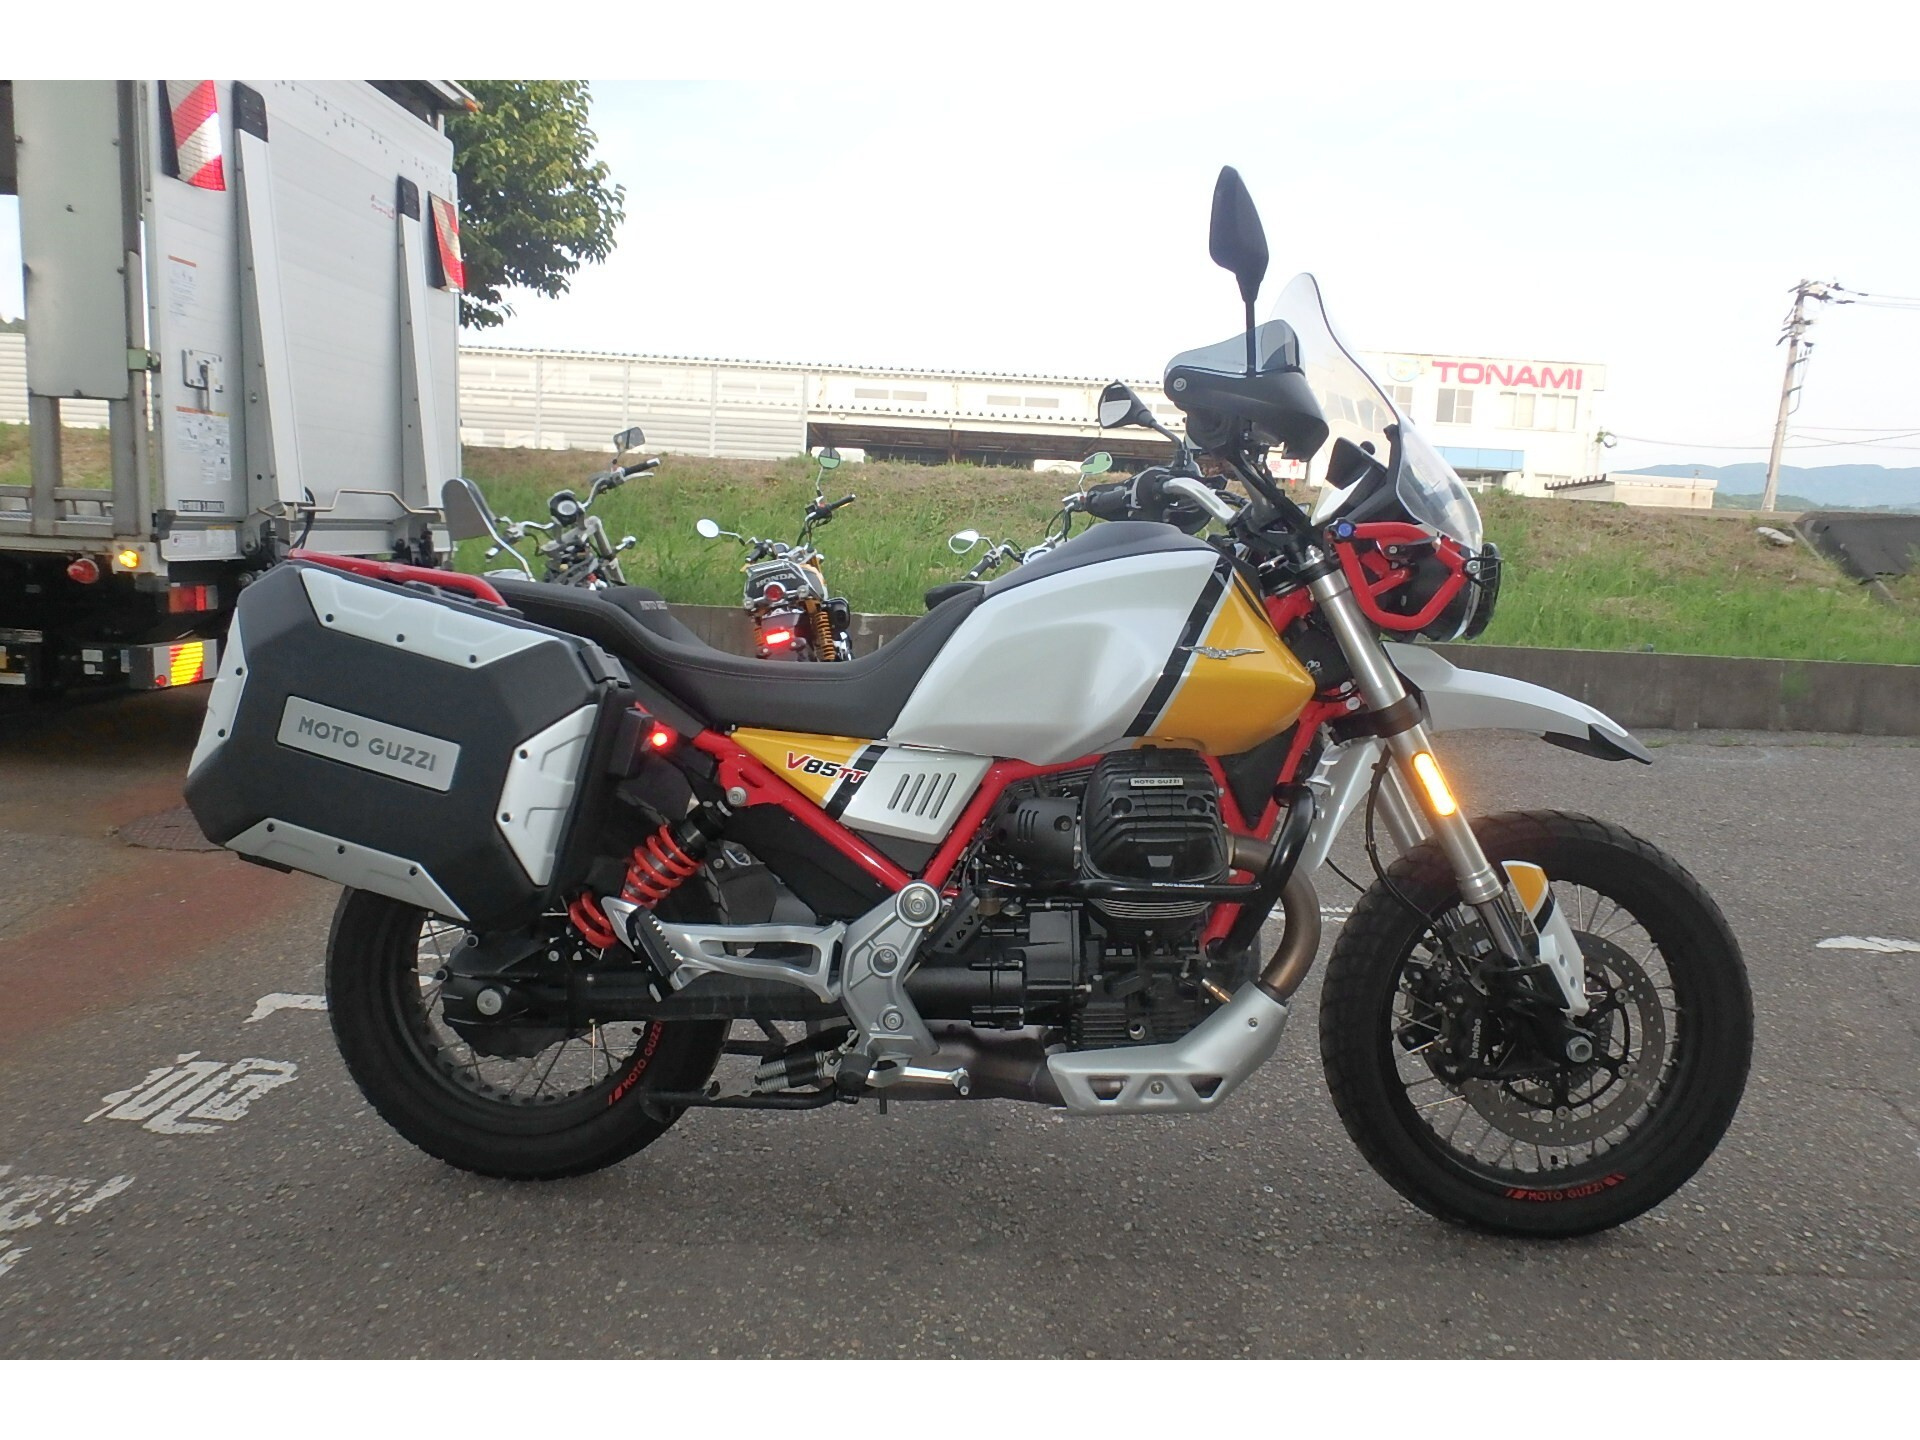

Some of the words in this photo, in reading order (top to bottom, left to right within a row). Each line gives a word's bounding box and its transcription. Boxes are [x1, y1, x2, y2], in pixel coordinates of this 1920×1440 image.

[1431, 360, 1583, 391] TONAMI
[755, 572, 797, 588] HONDA
[298, 715, 360, 748] MOTO
[368, 737, 436, 772] GUZZI
[786, 751, 868, 783] V85TT
[1468, 1017, 1482, 1059] brembo
[622, 1059, 647, 1089] MOTO
[1527, 1190, 1563, 1202] MOTO
[1567, 1182, 1605, 1199] GUZZI
